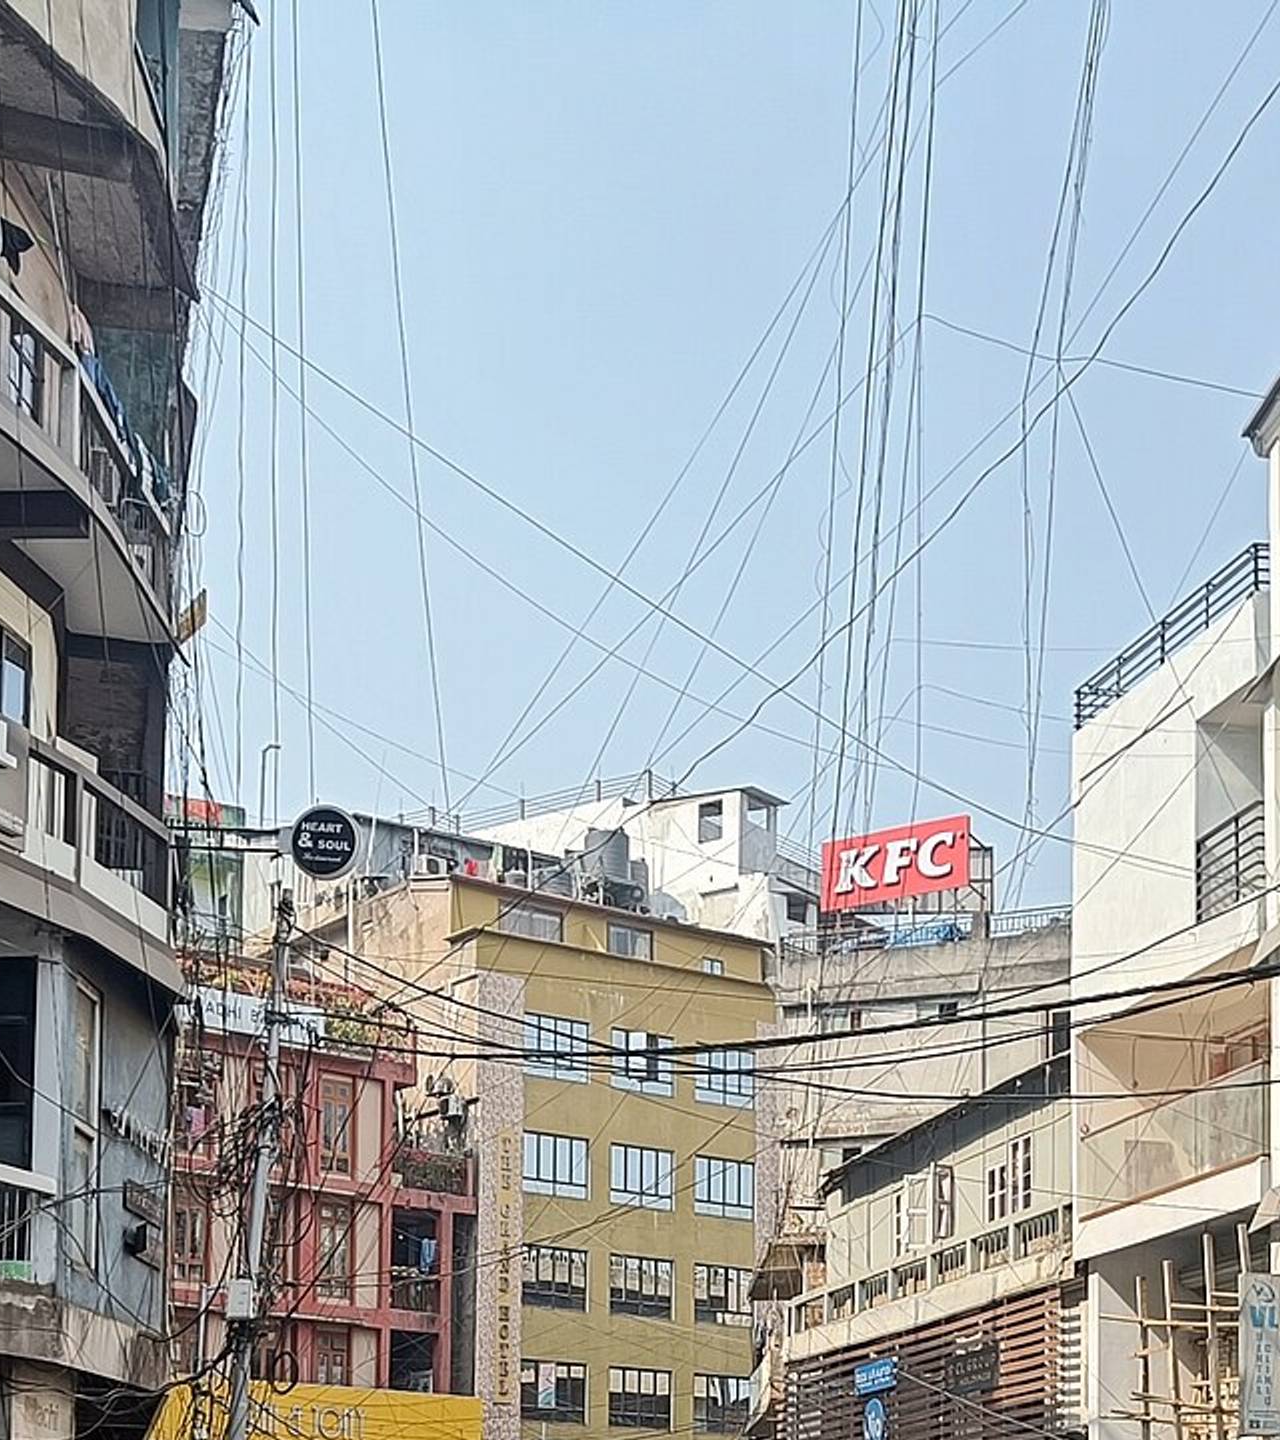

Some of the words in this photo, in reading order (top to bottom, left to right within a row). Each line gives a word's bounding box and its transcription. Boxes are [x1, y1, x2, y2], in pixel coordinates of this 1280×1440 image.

[301, 820, 344, 834] HEART
[297, 831, 313, 848] &
[317, 838, 352, 851] SOUL
[833, 831, 956, 895] KFC
